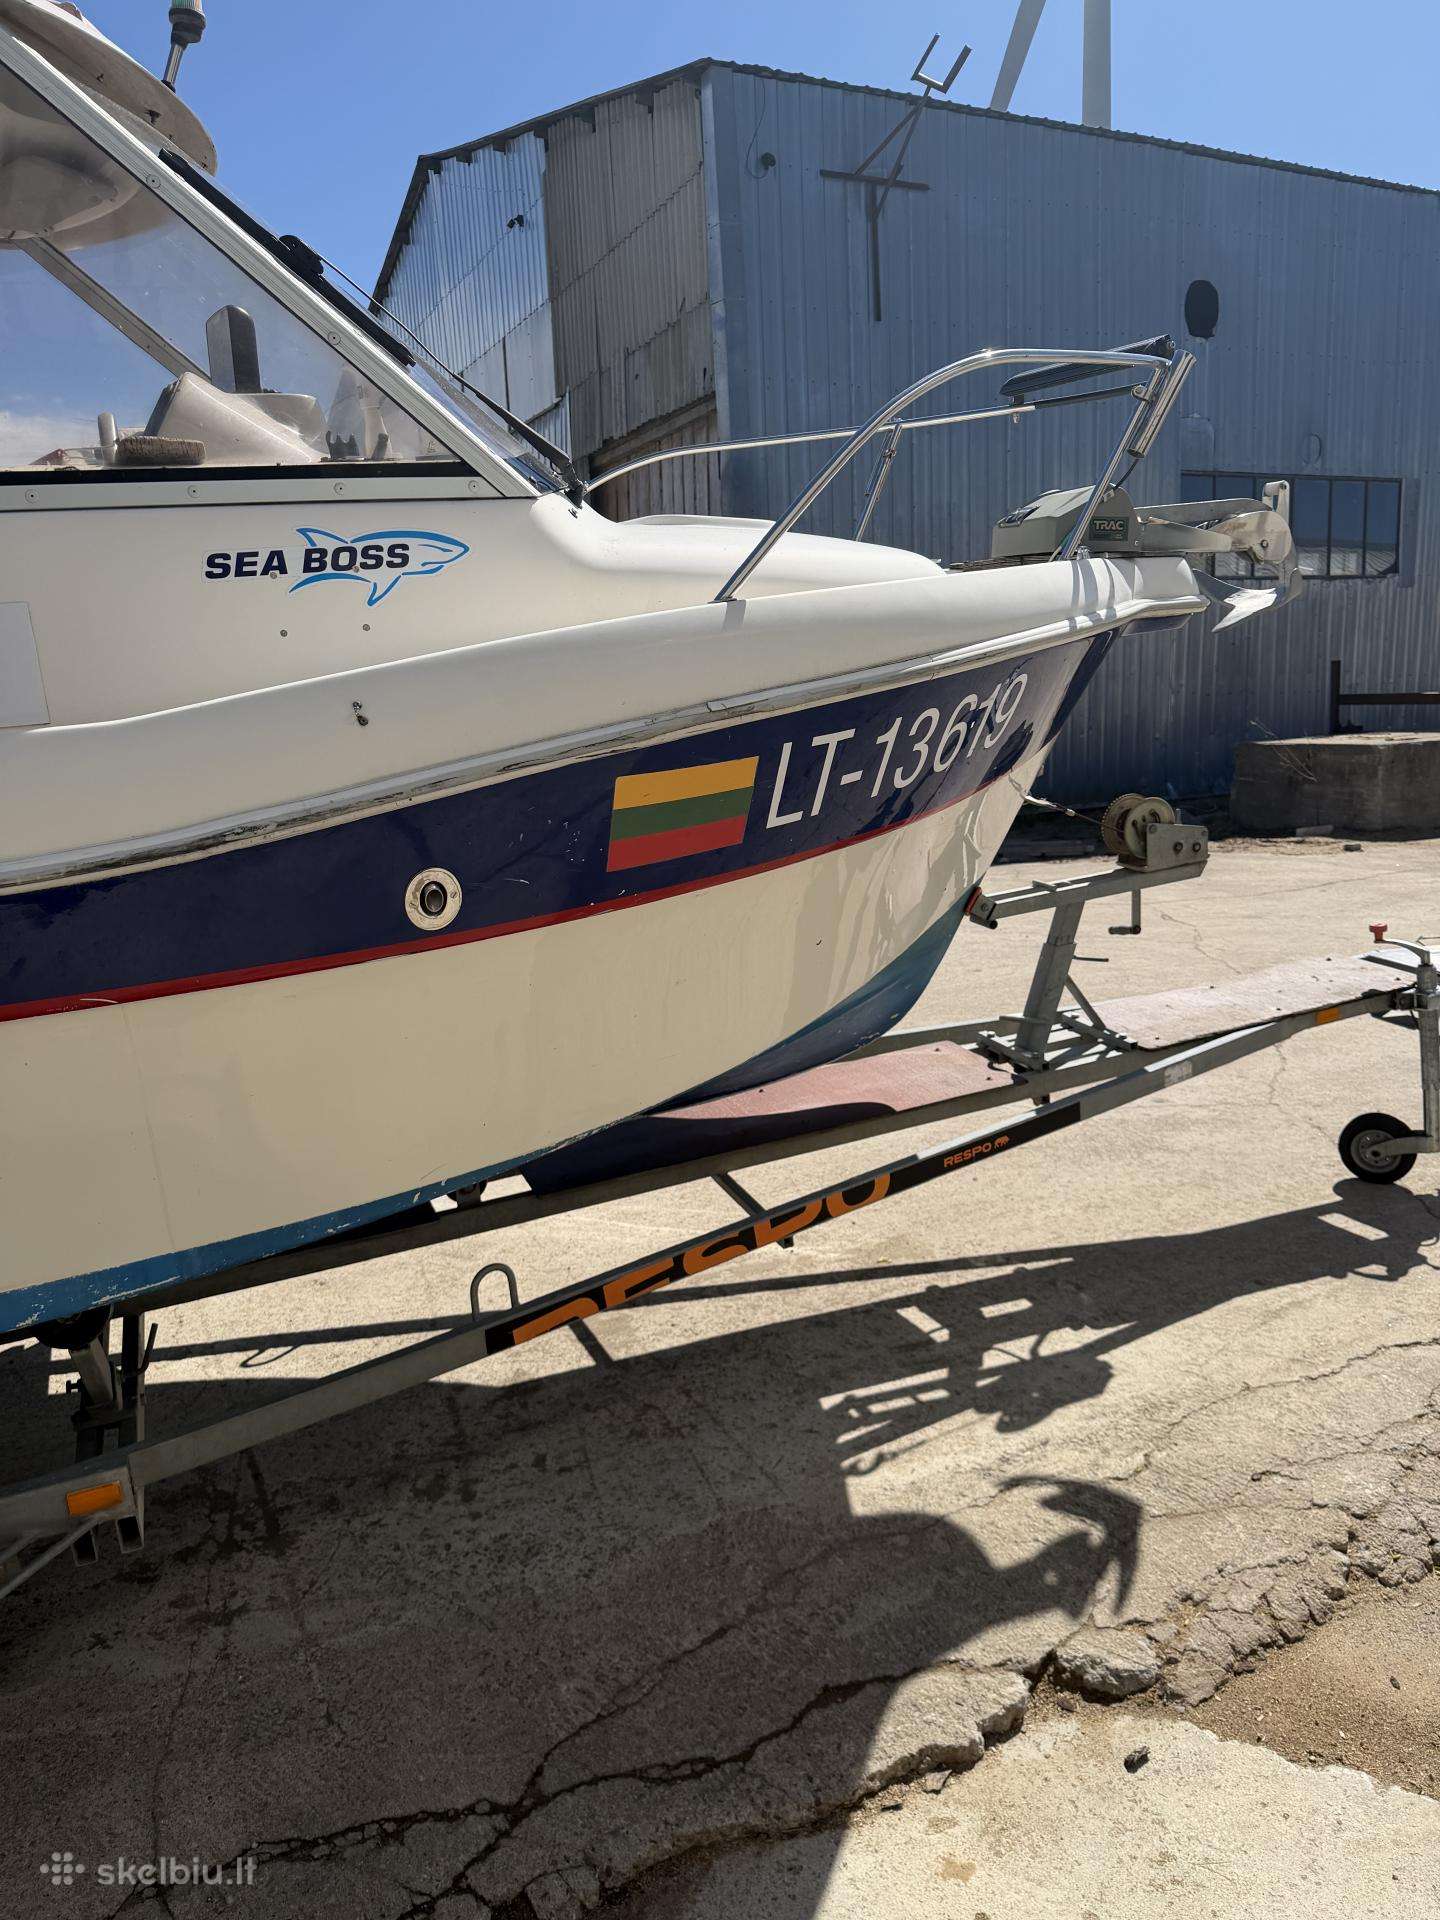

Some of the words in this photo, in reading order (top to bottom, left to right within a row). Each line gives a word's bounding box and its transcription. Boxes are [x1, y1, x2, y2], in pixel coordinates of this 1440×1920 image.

[1093, 520, 1124, 530] TRAC
[204, 550, 289, 580] SEA
[302, 543, 410, 574] BOSS
[766, 673, 1028, 829] LT-13619
[943, 1142, 992, 1168] RESPO
